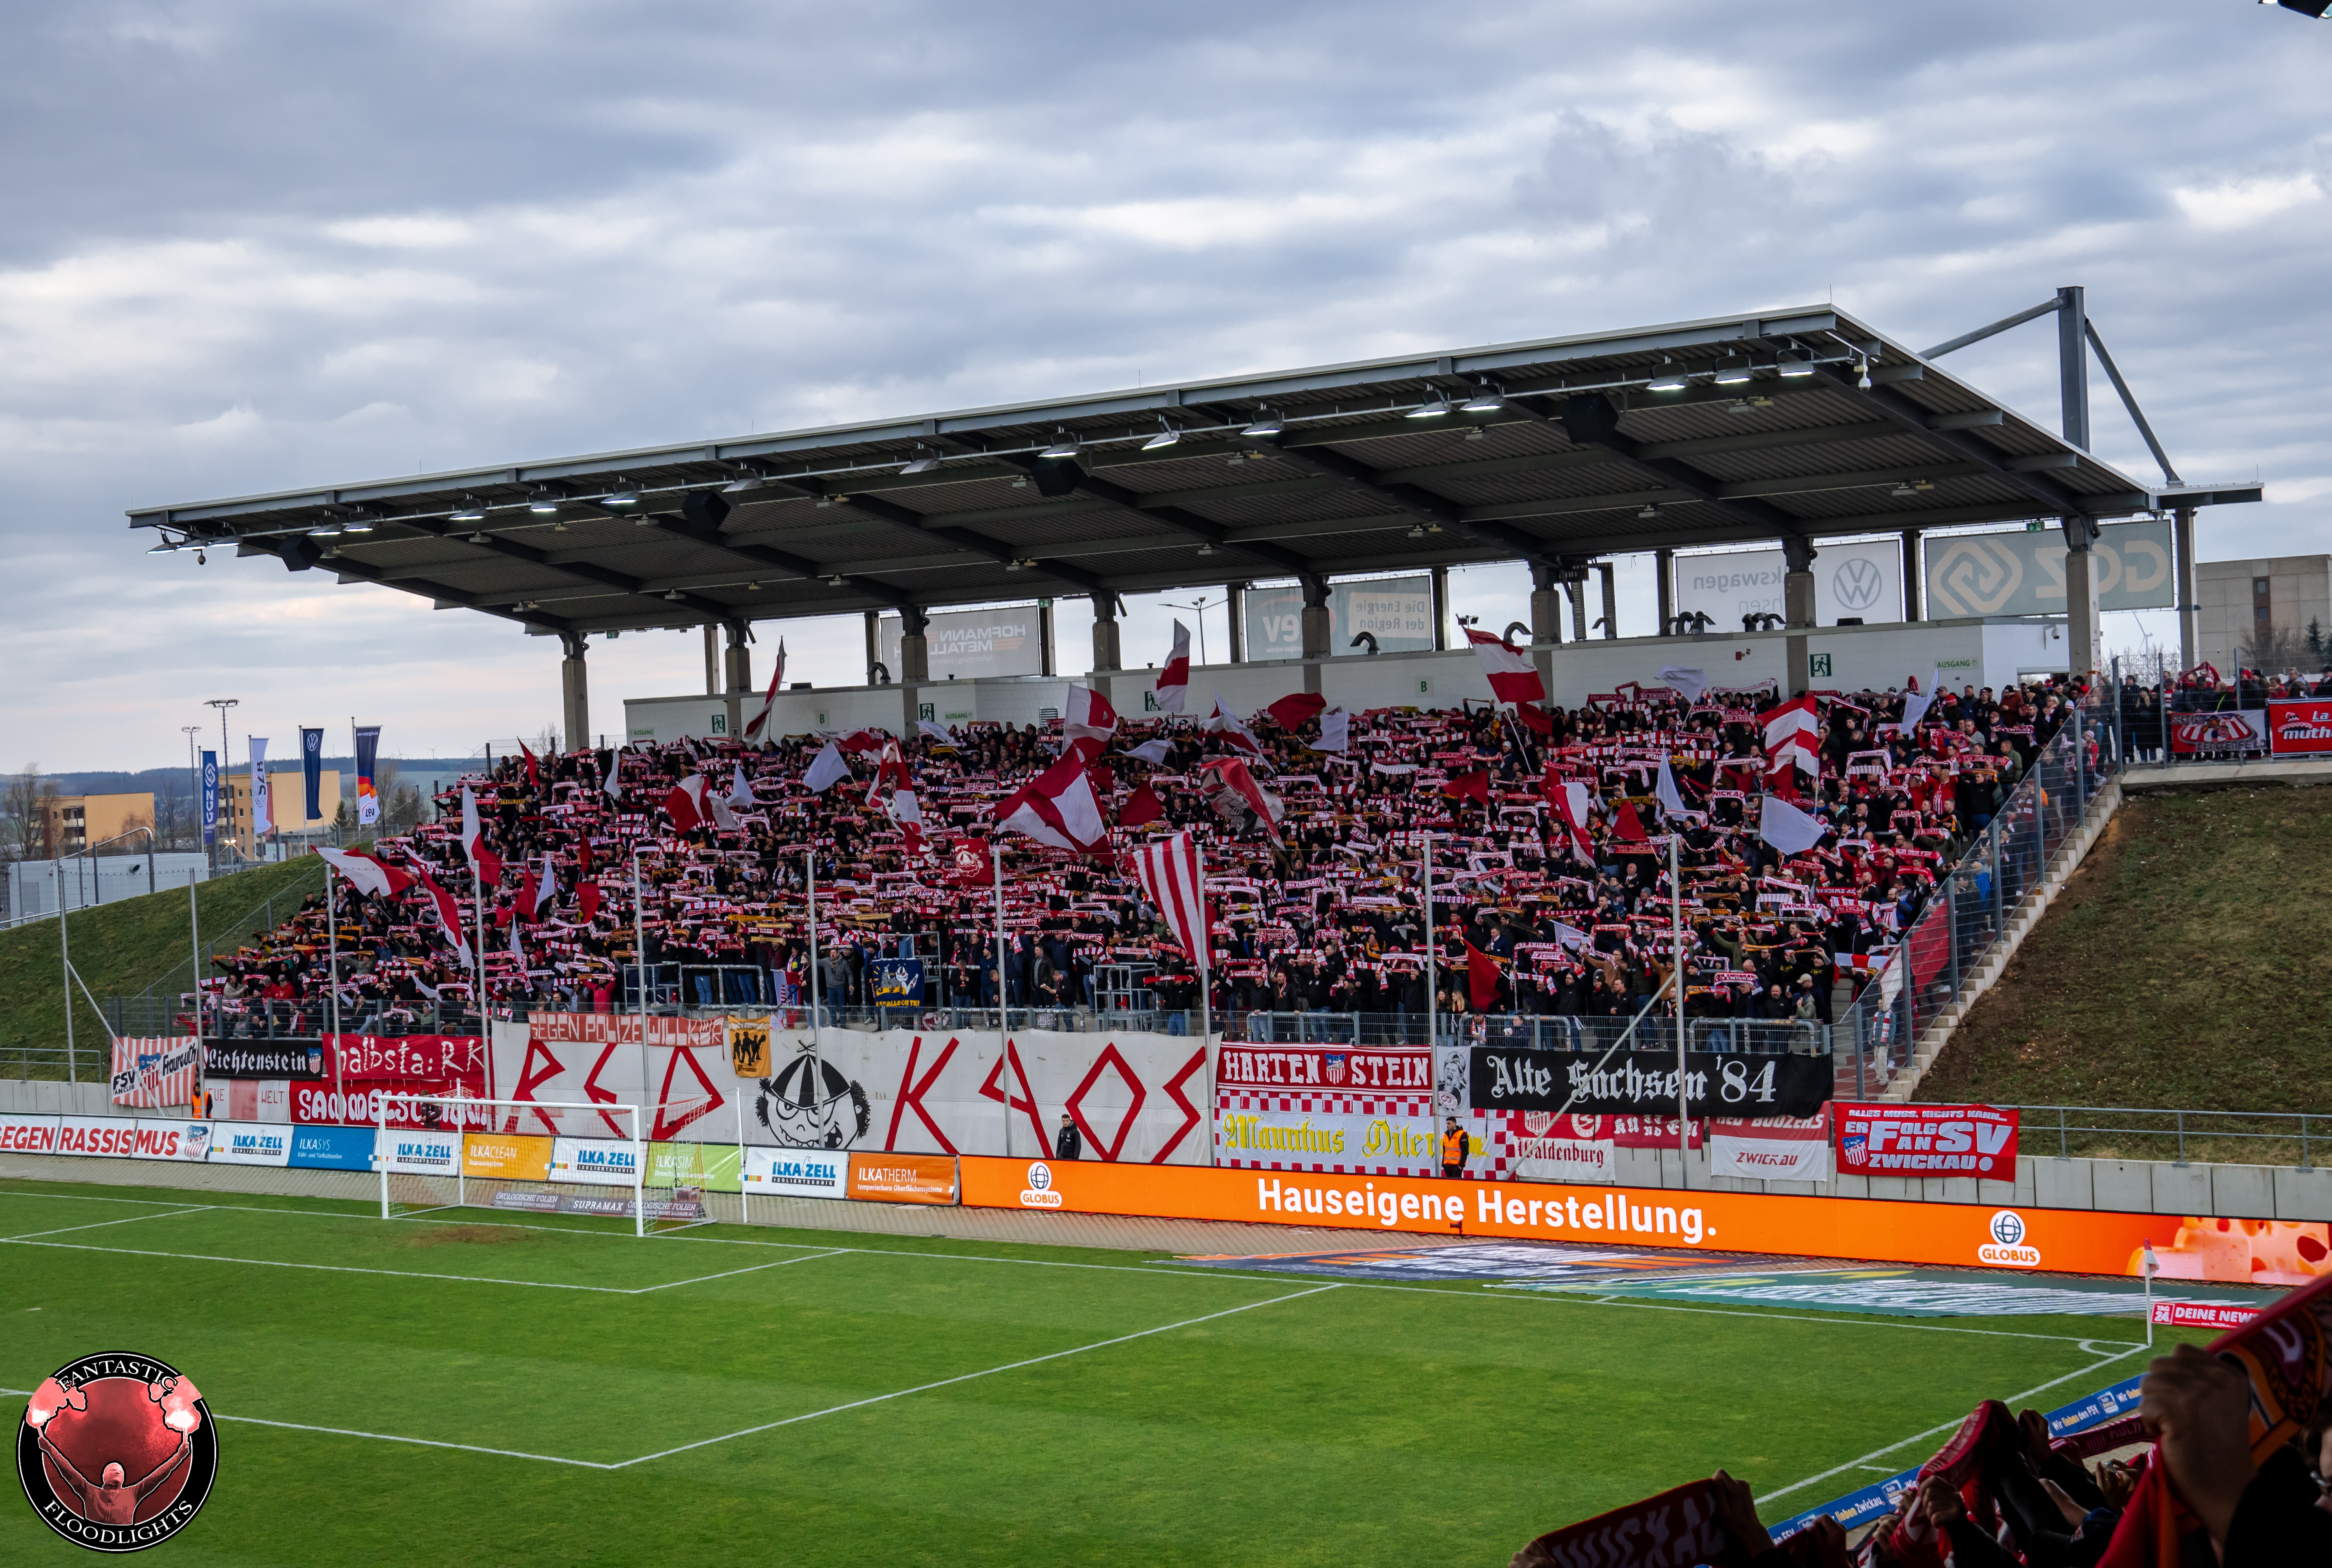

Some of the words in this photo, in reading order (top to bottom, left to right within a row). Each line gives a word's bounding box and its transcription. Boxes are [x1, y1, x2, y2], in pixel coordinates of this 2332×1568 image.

[1937, 659, 1970, 668] AUSGANG
[1421, 681, 1427, 692] B
[820, 714, 825, 724] B
[2312, 711, 2329, 720] La
[526, 922, 549, 930] ZWICKAU
[209, 1048, 307, 1075] Lichtenstein
[1224, 1051, 1320, 1083] HARTEN
[1351, 1055, 1428, 1087] STEIN
[113, 1072, 135, 1089] FSV
[1487, 1055, 1552, 1098] Alte
[1567, 1057, 1708, 1103] Sachsen
[205, 1088, 225, 1101] EUE
[261, 1090, 284, 1104] WELT
[1849, 1109, 1881, 1118] ALLES
[1884, 1110, 1919, 1118] MUSS.
[0, 1126, 55, 1150] EGEN
[59, 1127, 180, 1156] RASSISMUS
[233, 1135, 256, 1147] ILKA
[258, 1136, 283, 1148] ZELL
[1223, 1113, 1345, 1158] Mauritius
[299, 1138, 331, 1150] ILKASYS
[398, 1143, 422, 1156] ILKA
[426, 1145, 451, 1158] ZELL
[471, 1145, 517, 1159] ILKACLEAN
[578, 1150, 605, 1164] ILKA
[1518, 1139, 1604, 1168] Waldenburg
[1736, 1152, 1799, 1165] ZWICKAU
[772, 1162, 801, 1176] ILKA
[805, 1164, 836, 1178] ZELL
[859, 1167, 916, 1182] ILKATHERM
[772, 1178, 834, 1186] ISOLIERTECHNIK
[858, 1183, 892, 1192] temperierbare
[894, 1185, 943, 1193] Oberflächensysteme
[496, 1191, 536, 1202] ÖKOLOGISCHE
[536, 1194, 558, 1203] FOLIEN
[1023, 1193, 1060, 1205] GLOBUS
[573, 1200, 624, 1211] SUPRAMAX
[627, 1200, 671, 1210] ÖKLOGISCHE
[672, 1203, 696, 1211] FOLIEN
[1258, 1178, 1464, 1226] Hauseigene
[1478, 1189, 1716, 1244] Herstellung.
[1982, 1248, 2036, 1262] GLOBUS
[2155, 1311, 2169, 1321] 24
[2175, 1307, 2216, 1320] DEINE
[2116, 1393, 2127, 1403] Wir
[2052, 1420, 2063, 1431] Wir
[2062, 1414, 2080, 1427] lieben
[2078, 1411, 2089, 1420] den
[1835, 1506, 1858, 1522] lieben
